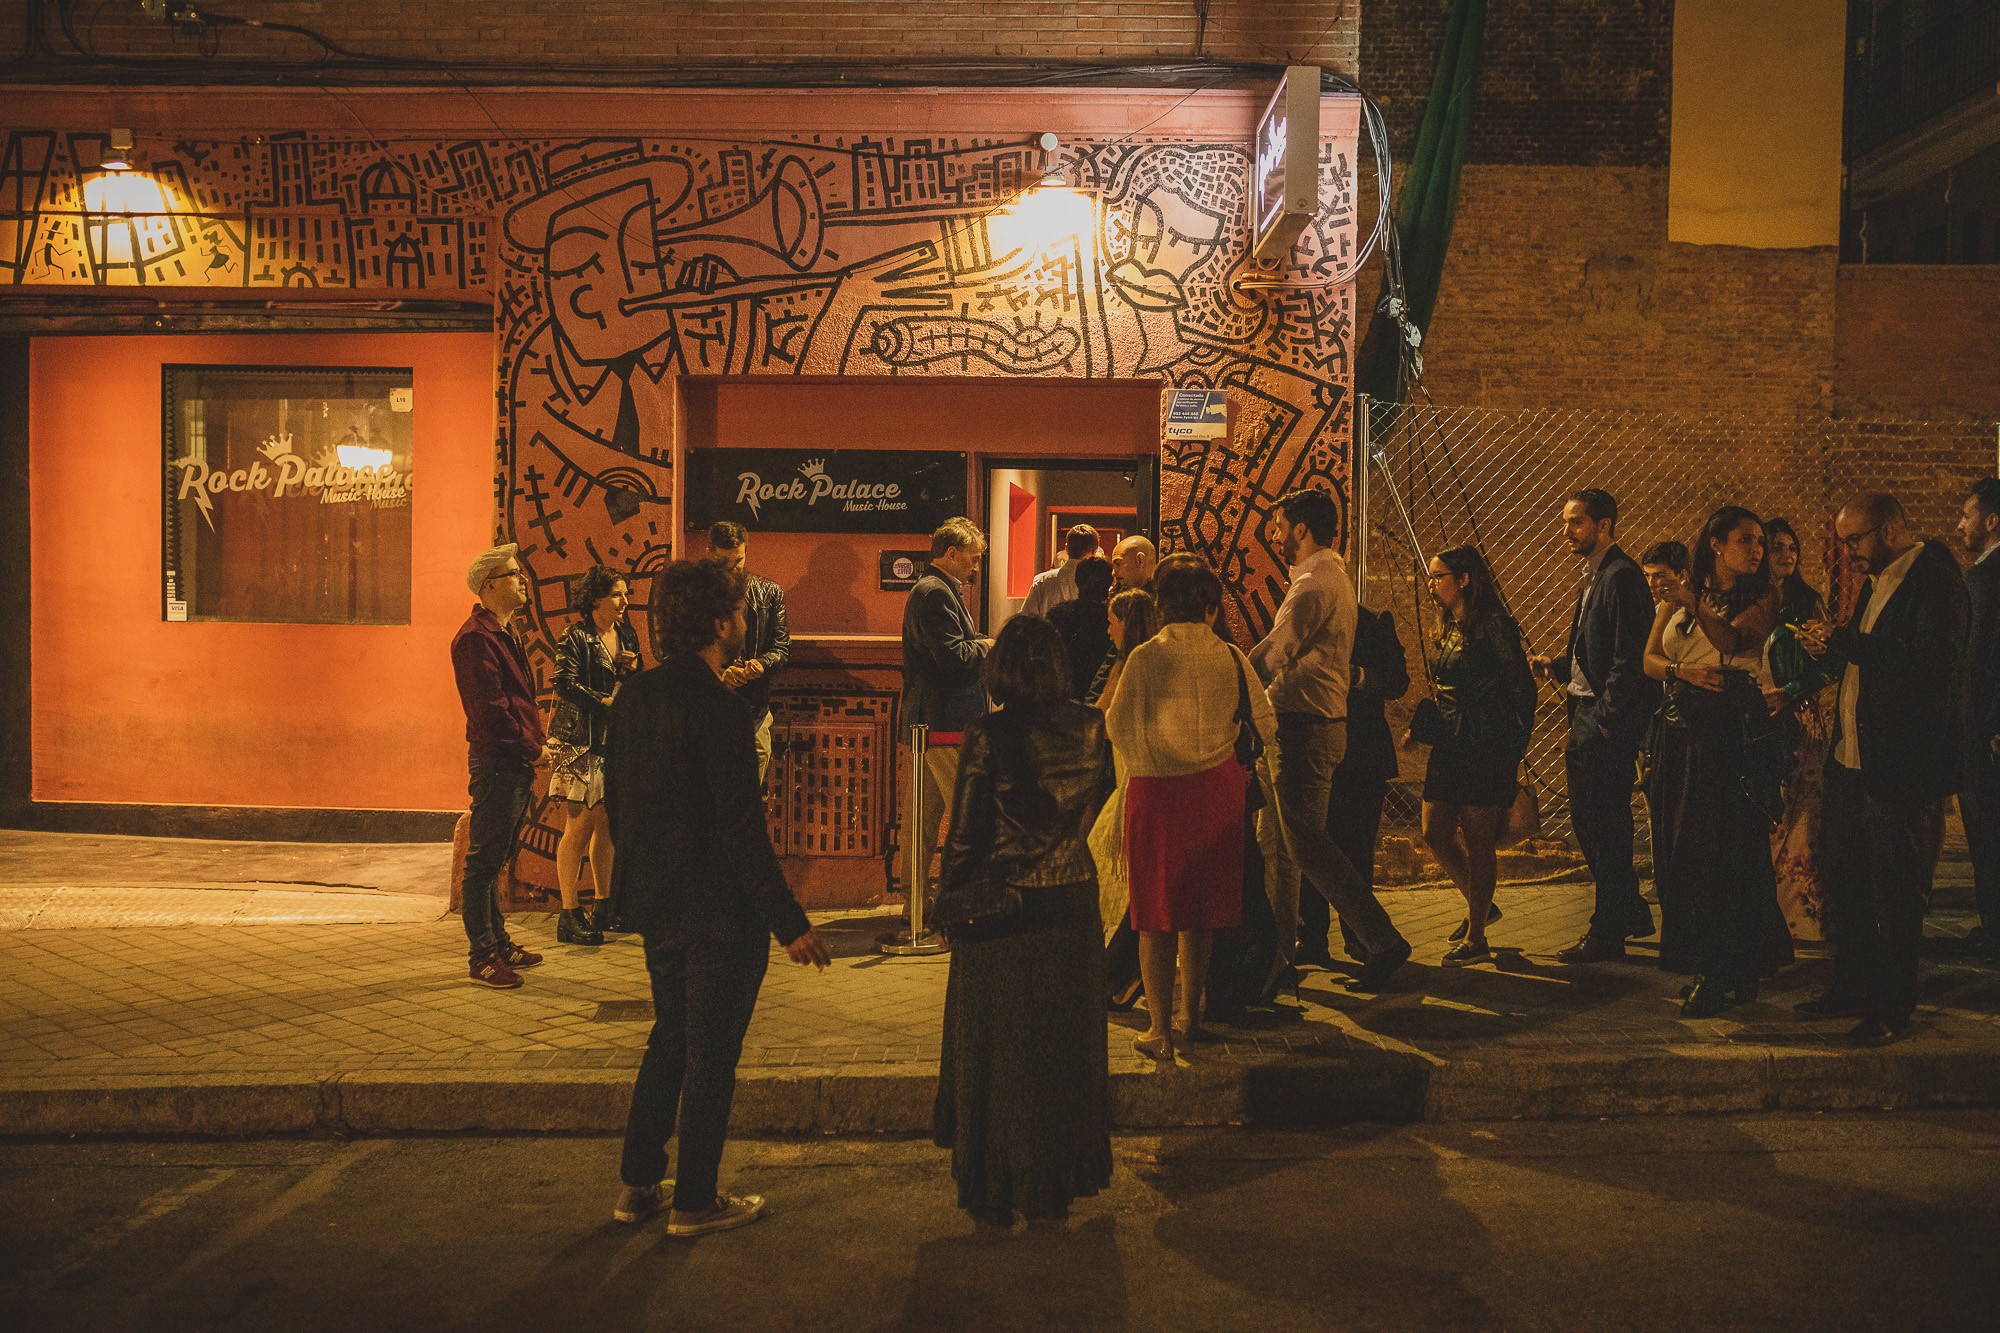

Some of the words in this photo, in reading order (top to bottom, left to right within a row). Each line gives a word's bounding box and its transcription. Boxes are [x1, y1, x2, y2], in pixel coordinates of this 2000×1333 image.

[1168, 426, 1193, 436] tyco
[177, 455, 272, 533] Rock
[274, 453, 397, 498] Palace
[320, 487, 361, 504] Music
[363, 484, 407, 500] House
[735, 471, 807, 522] Rock
[808, 473, 902, 506] Palace
[842, 499, 875, 512] Music
[875, 498, 908, 511] House
